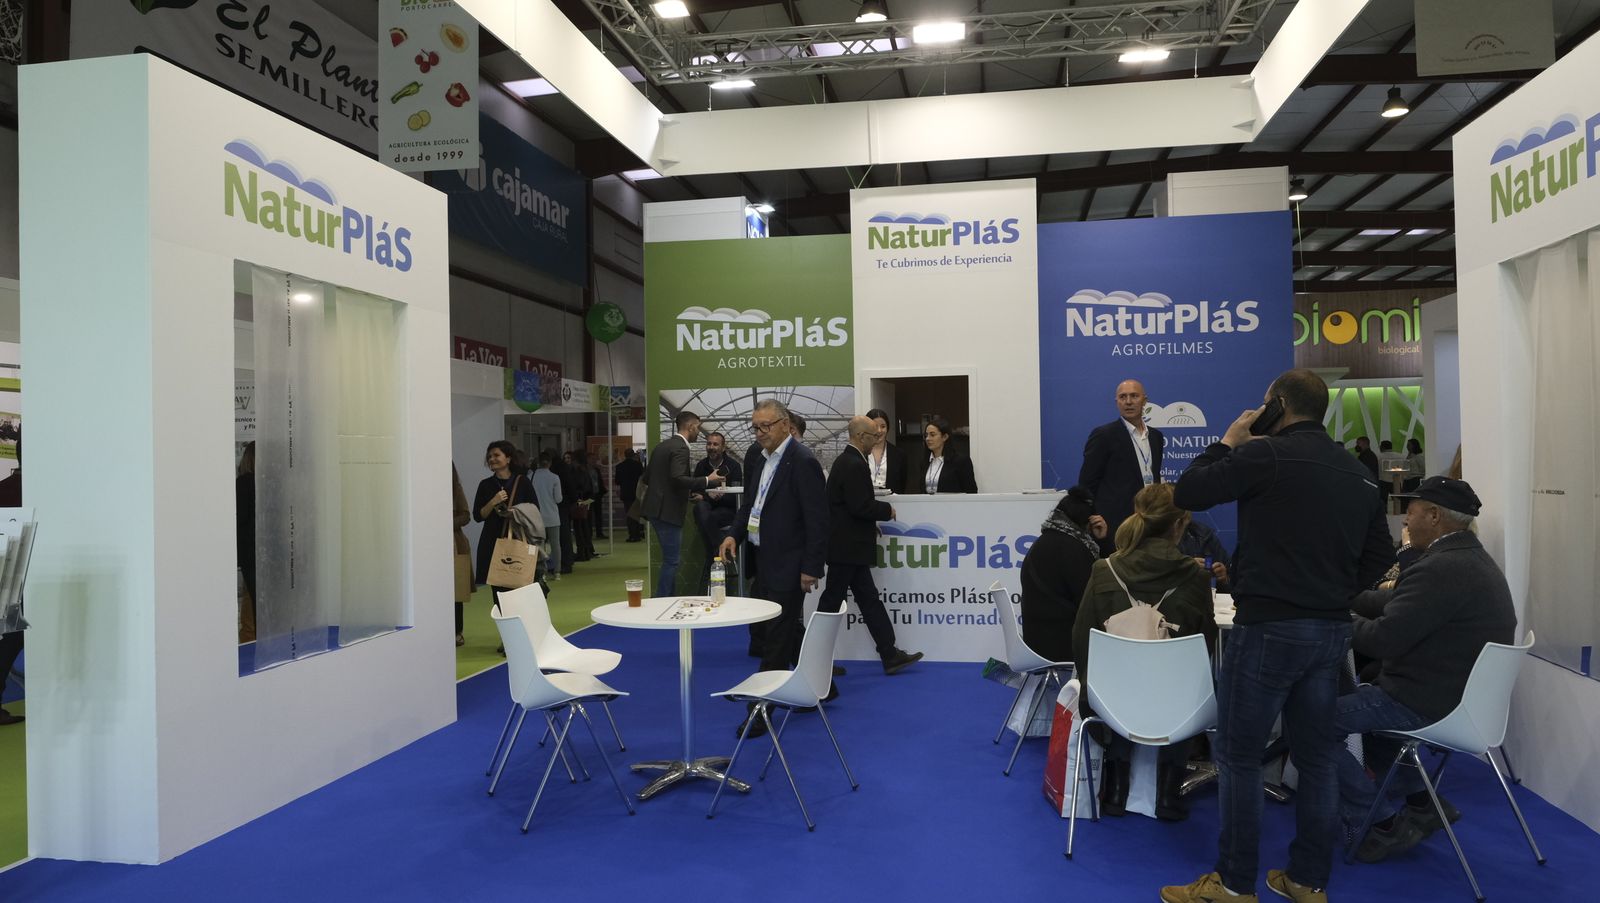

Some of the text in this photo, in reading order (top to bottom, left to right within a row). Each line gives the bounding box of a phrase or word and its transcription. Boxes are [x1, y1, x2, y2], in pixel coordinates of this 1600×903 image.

[216, 0, 270, 40] El
[389, 136, 470, 149] AGRICULTURA ECOLÓGICA
[394, 150, 464, 163] desde 1999
[492, 167, 570, 229] cajamar
[224, 161, 412, 272] NaturPláS
[868, 217, 1020, 250] NaturPláS
[876, 252, 1013, 269] Te Cubrimos de Experiencia
[1066, 300, 1260, 338] NaturPláS
[676, 316, 848, 352] NaturPláS
[1111, 341, 1214, 356] AGROFILMES
[1377, 344, 1420, 356] biological
[717, 355, 806, 369] AGROTEXTIL
[1160, 467, 1178, 476] olar,
[873, 534, 1038, 569] aturPláS
[950, 586, 1021, 604] Plásto
[889, 609, 912, 625] Tu
[917, 607, 1025, 626] Invernado
